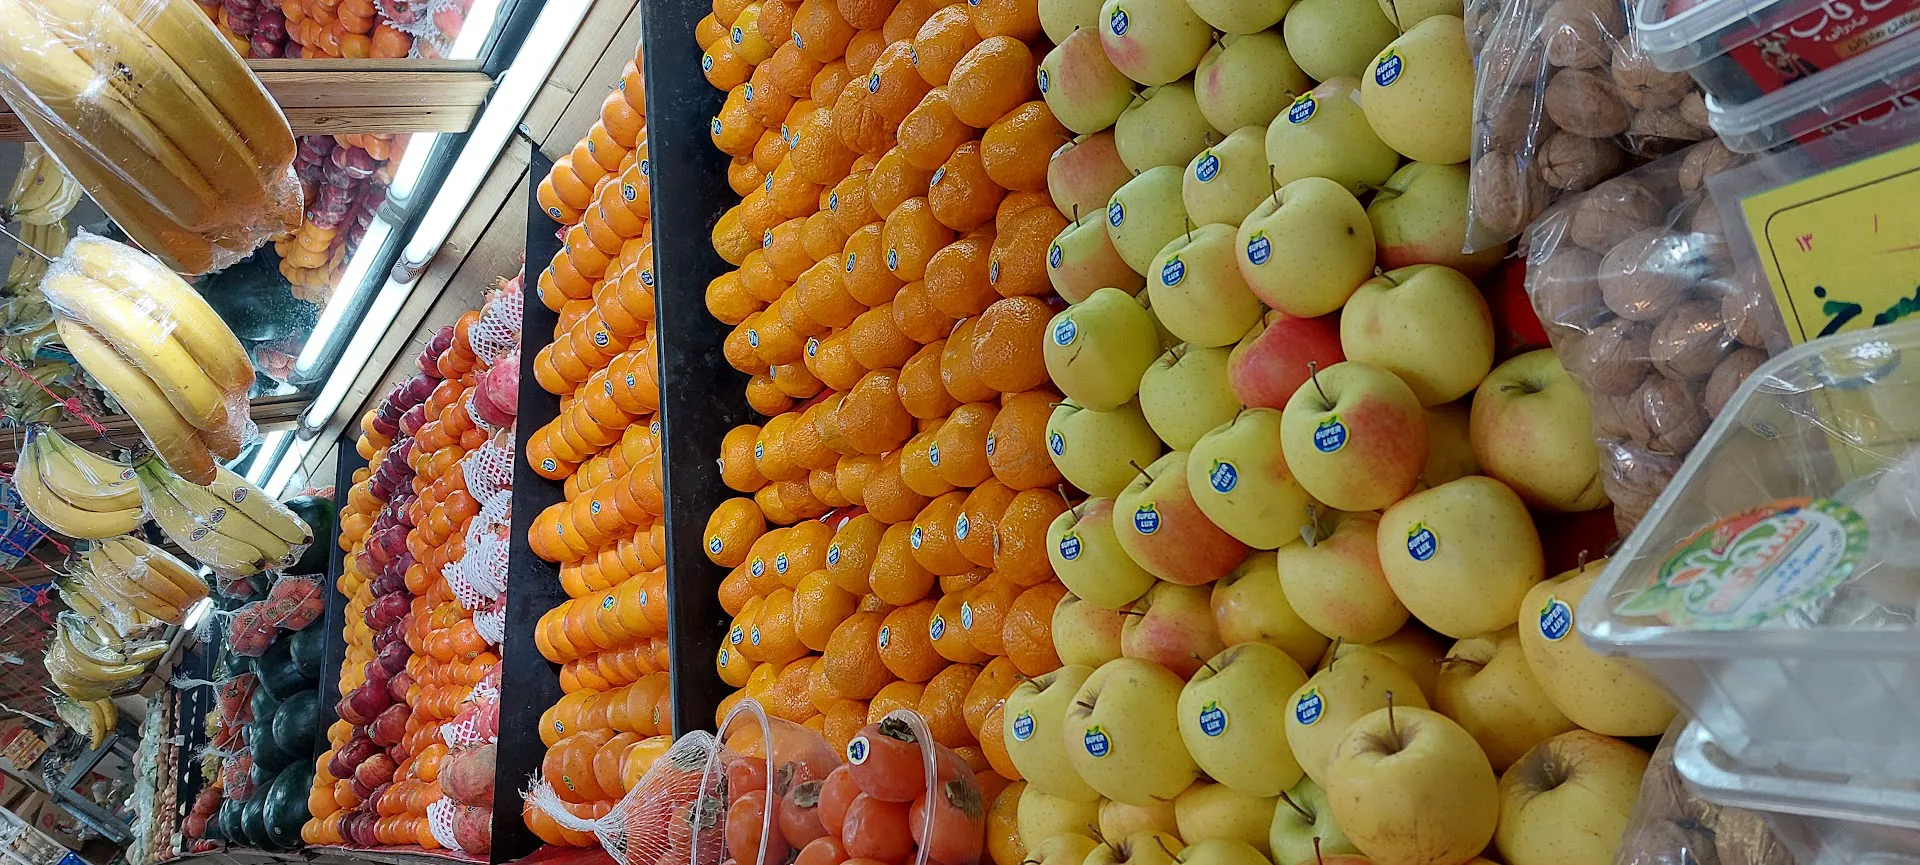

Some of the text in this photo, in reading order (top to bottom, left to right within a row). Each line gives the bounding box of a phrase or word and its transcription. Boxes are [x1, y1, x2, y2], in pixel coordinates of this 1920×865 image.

[1376, 57, 1398, 76] SUPER
[1382, 67, 1396, 80] LUX
[1290, 100, 1312, 115] SUPER
[1295, 108, 1309, 119] LUX
[1198, 156, 1215, 174] SUPER
[1202, 164, 1214, 177] LUX
[1248, 239, 1268, 253] SUPER
[1253, 248, 1267, 260] LUX
[1162, 261, 1182, 276] SUPER
[1167, 269, 1180, 281] LUX
[1056, 322, 1072, 335] SUPER
[1060, 330, 1071, 341] LUX
[1316, 424, 1342, 440] SUPER
[1322, 434, 1339, 447] LUX
[1211, 463, 1229, 487] SUPER
[1220, 470, 1233, 488] LUX
[1136, 511, 1157, 520] SUPER
[1140, 519, 1154, 528] LUX
[1061, 538, 1078, 549] SUPER
[1409, 530, 1430, 550] SUPER
[1065, 546, 1076, 555] LUX
[1416, 540, 1431, 556] LUX
[1541, 604, 1562, 631] SUPER
[1551, 615, 1566, 634] LUX
[1298, 696, 1319, 713] SUPER
[1200, 710, 1221, 724] SUPER
[1302, 706, 1317, 720] LUX
[1014, 718, 1031, 728] SUPER
[1206, 719, 1220, 731] LUX
[1019, 726, 1029, 735] LUX
[1085, 733, 1105, 744] SUPER
[1091, 741, 1104, 752] LUX
